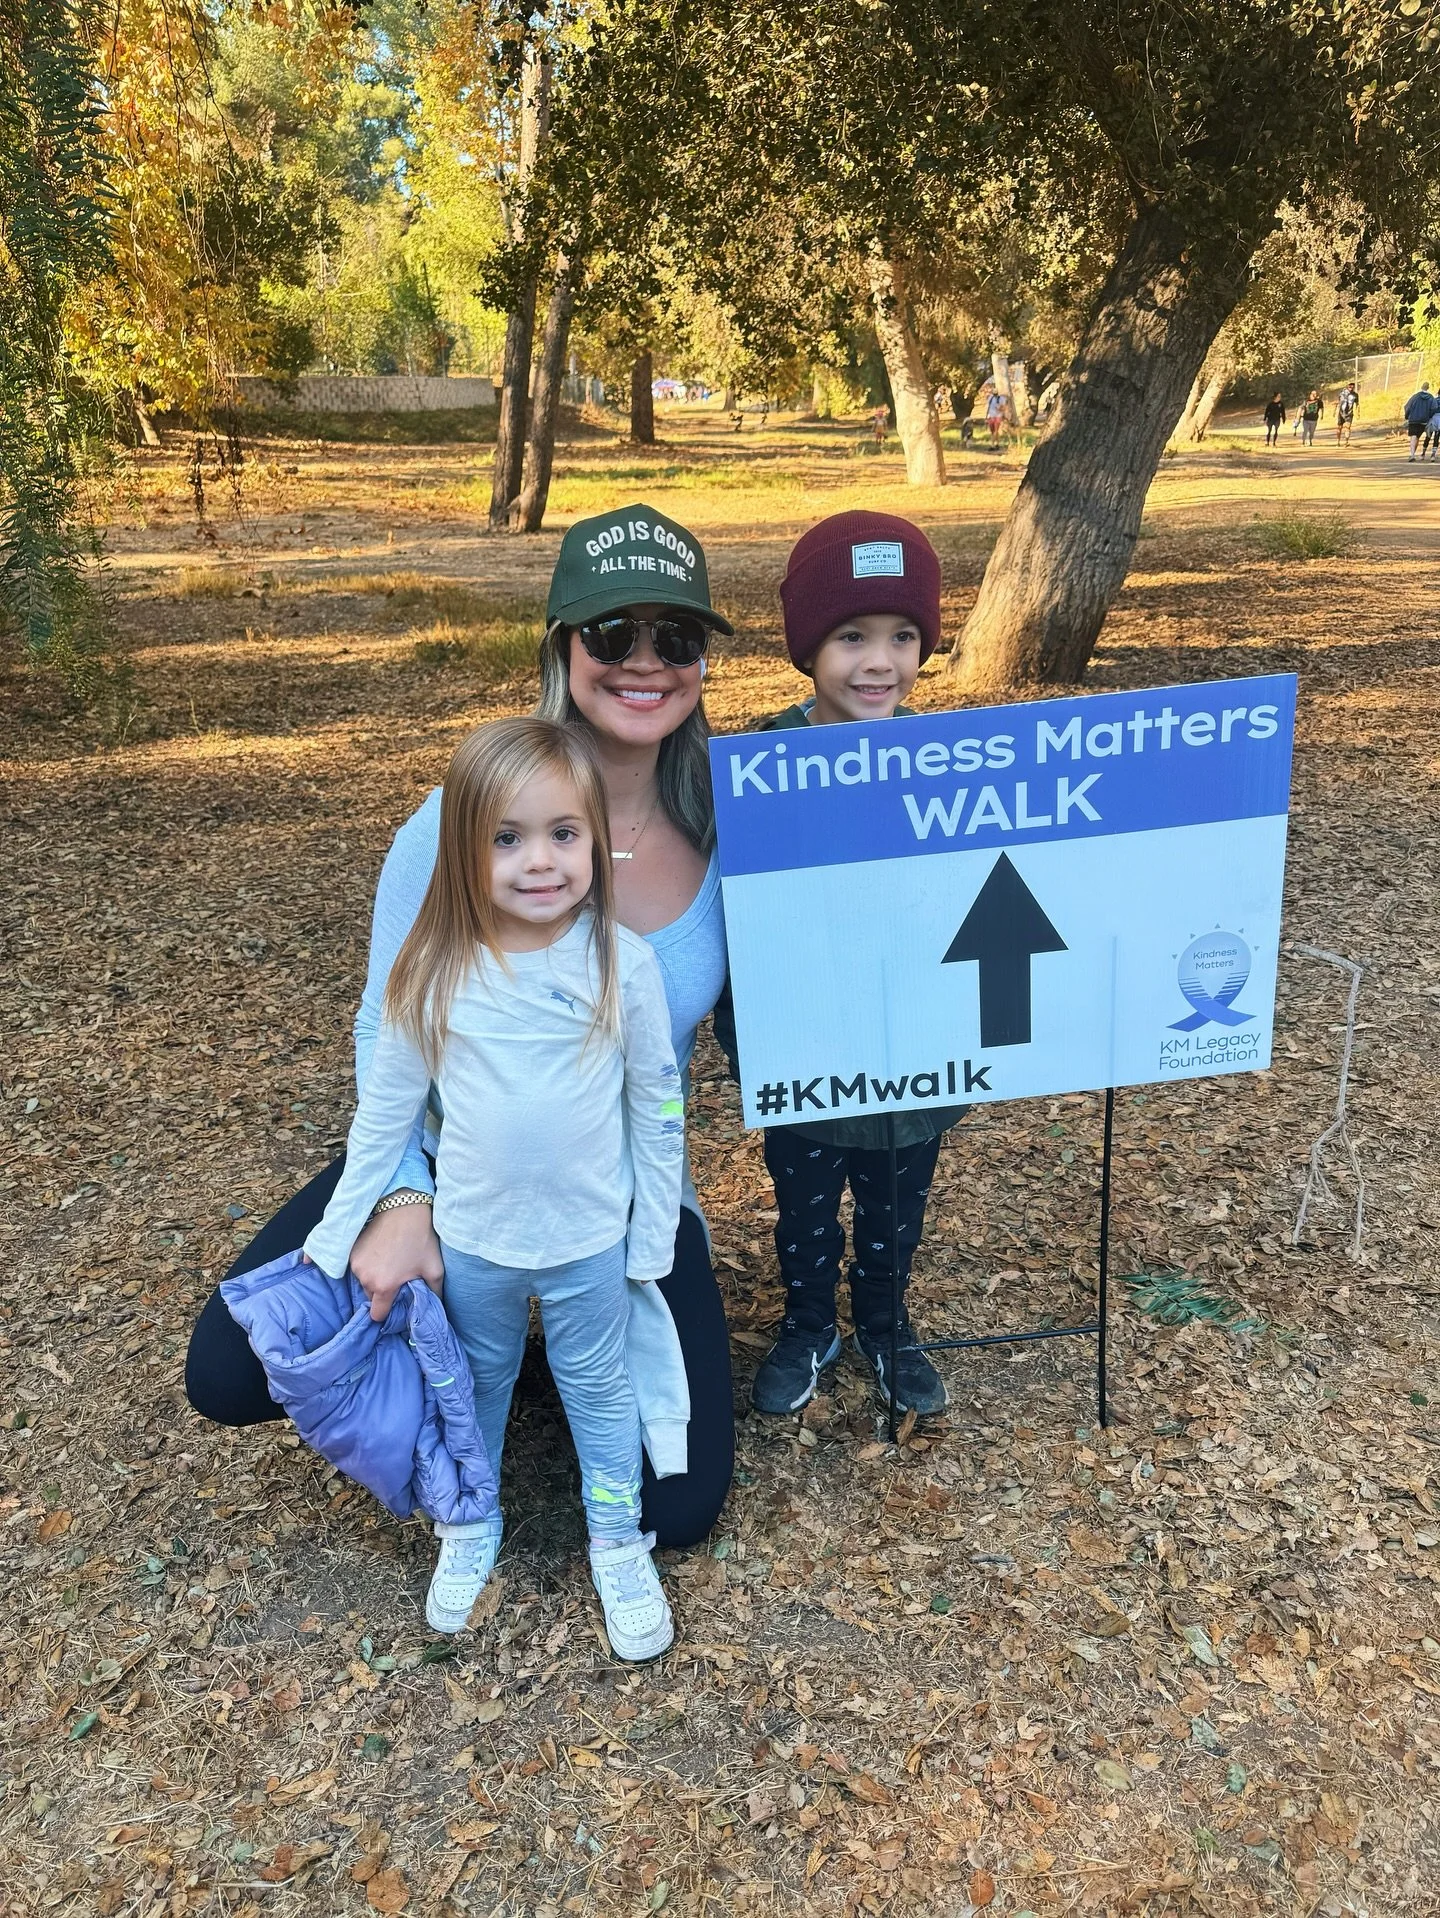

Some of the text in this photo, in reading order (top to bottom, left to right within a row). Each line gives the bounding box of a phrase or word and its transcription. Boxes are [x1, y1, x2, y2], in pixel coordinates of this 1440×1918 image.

[585, 521, 696, 569] GOD IS GOOD
[599, 556, 687, 582] ALL THE TIME
[730, 704, 1280, 798] Kindness Matters
[903, 773, 1103, 840] WALK
[1193, 948, 1237, 960] Kindness
[1195, 959, 1235, 971] Matters
[1160, 1032, 1262, 1055] KM Legacy
[1160, 1049, 1258, 1070] Foundation
[755, 1059, 993, 1117] #KMwalk
